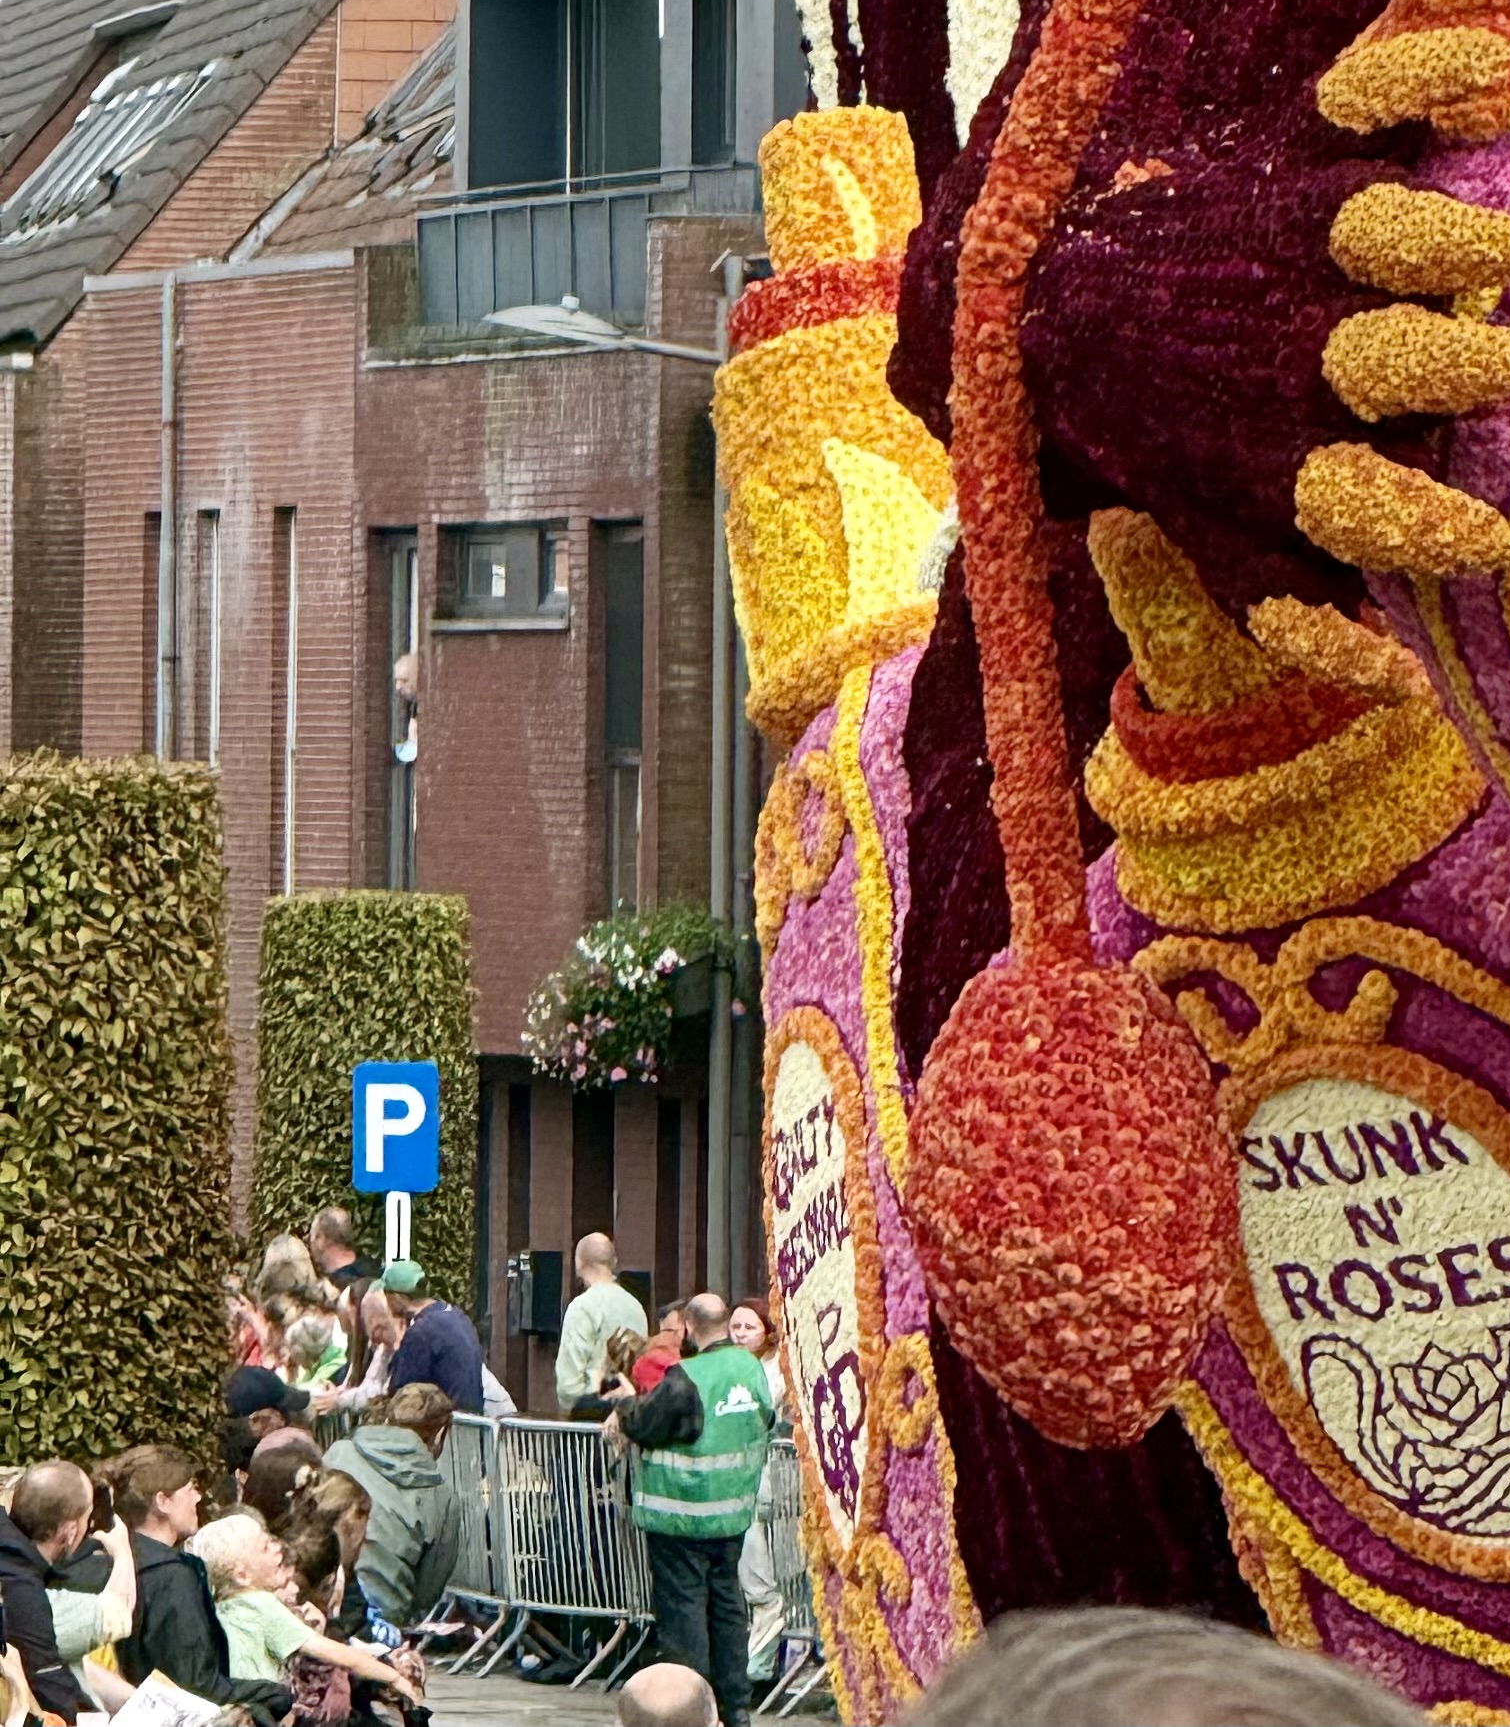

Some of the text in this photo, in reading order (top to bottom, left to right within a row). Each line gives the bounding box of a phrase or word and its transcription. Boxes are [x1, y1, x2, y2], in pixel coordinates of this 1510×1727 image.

[366, 1083, 426, 1173] P
[1239, 1112, 1469, 1191] SKUNK
[1344, 1196, 1404, 1248] N'
